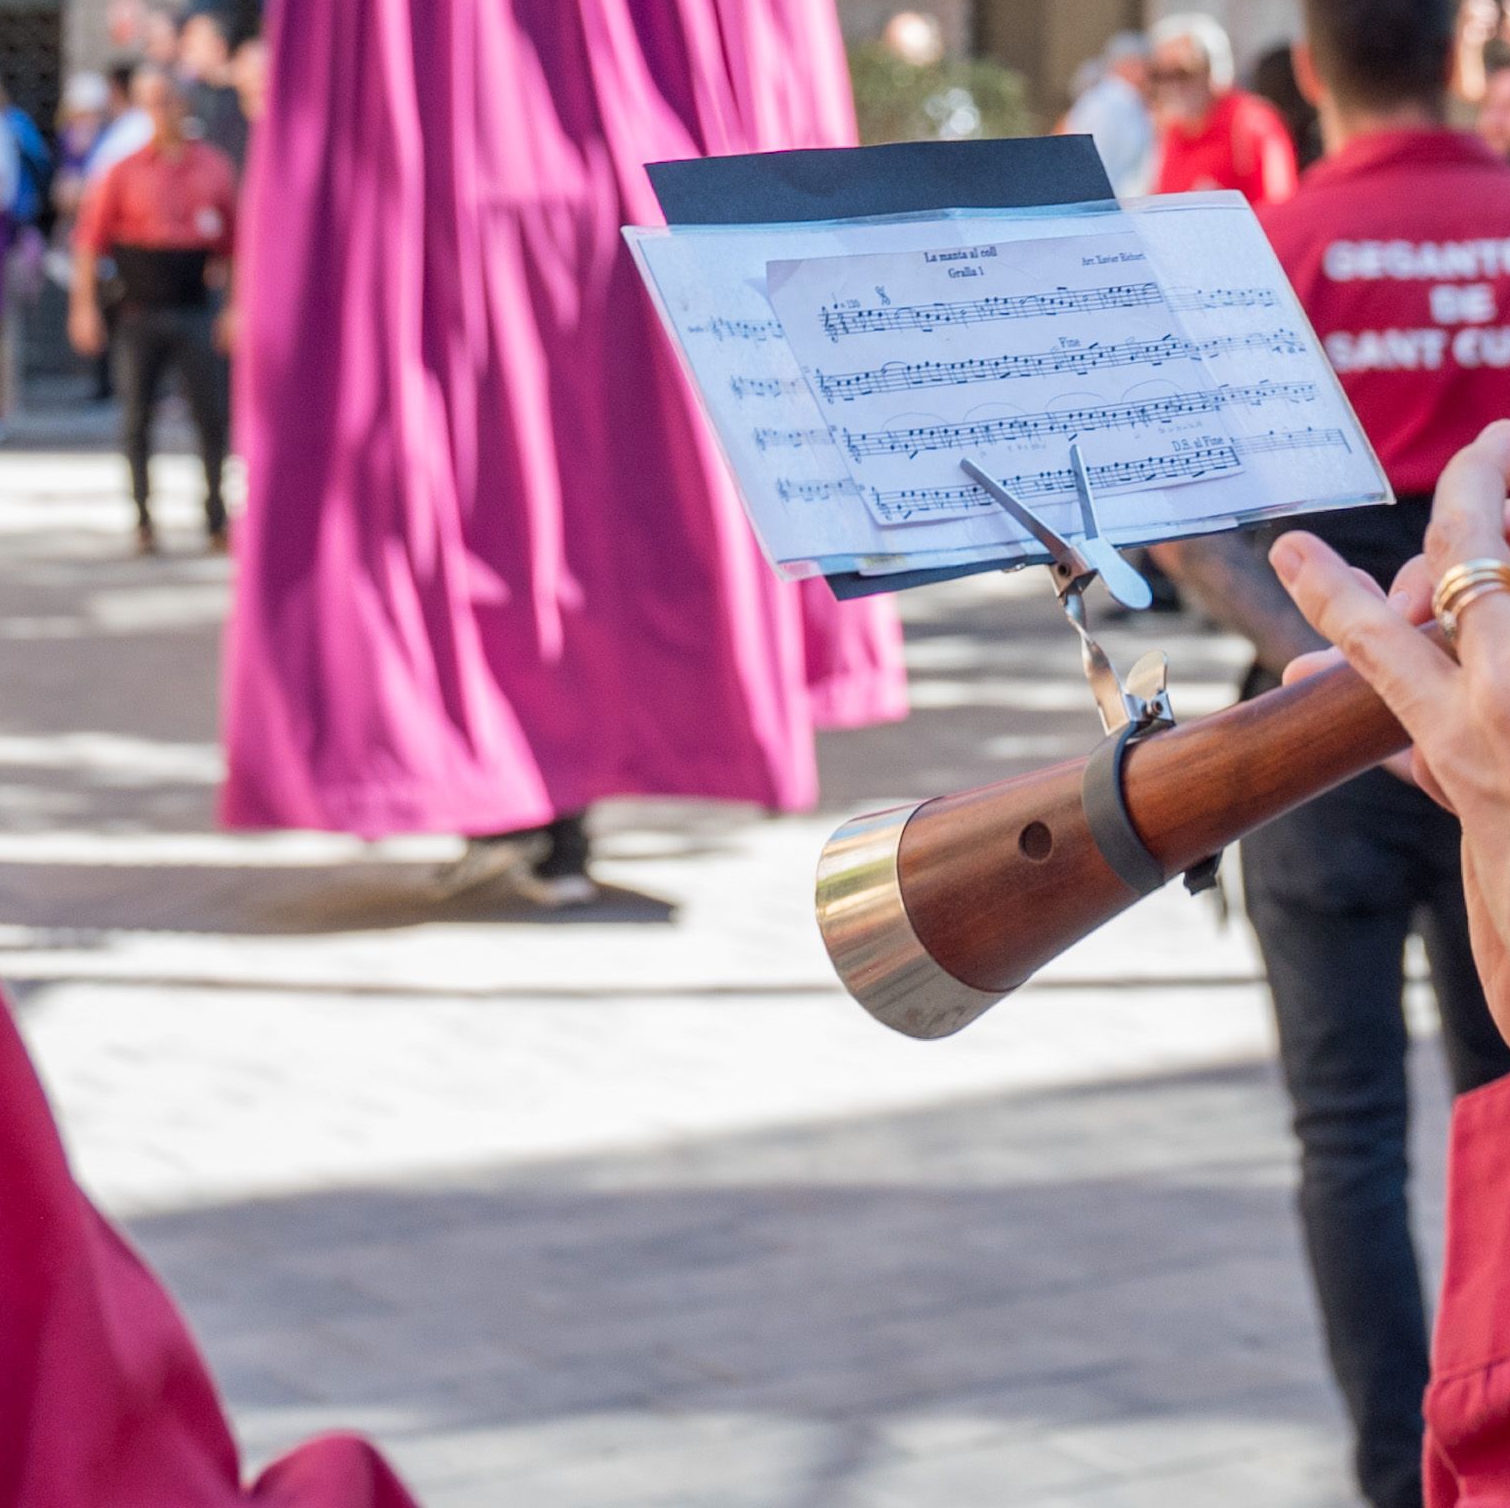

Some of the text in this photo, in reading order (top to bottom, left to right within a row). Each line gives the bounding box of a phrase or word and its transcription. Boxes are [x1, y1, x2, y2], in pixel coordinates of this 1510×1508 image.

[924, 252, 937, 263] La
[966, 248, 978, 260] al
[981, 246, 998, 258] coll
[948, 267, 975, 279] Gralla
[1059, 337, 1080, 348] Fine
[1324, 328, 1449, 373] SANT
